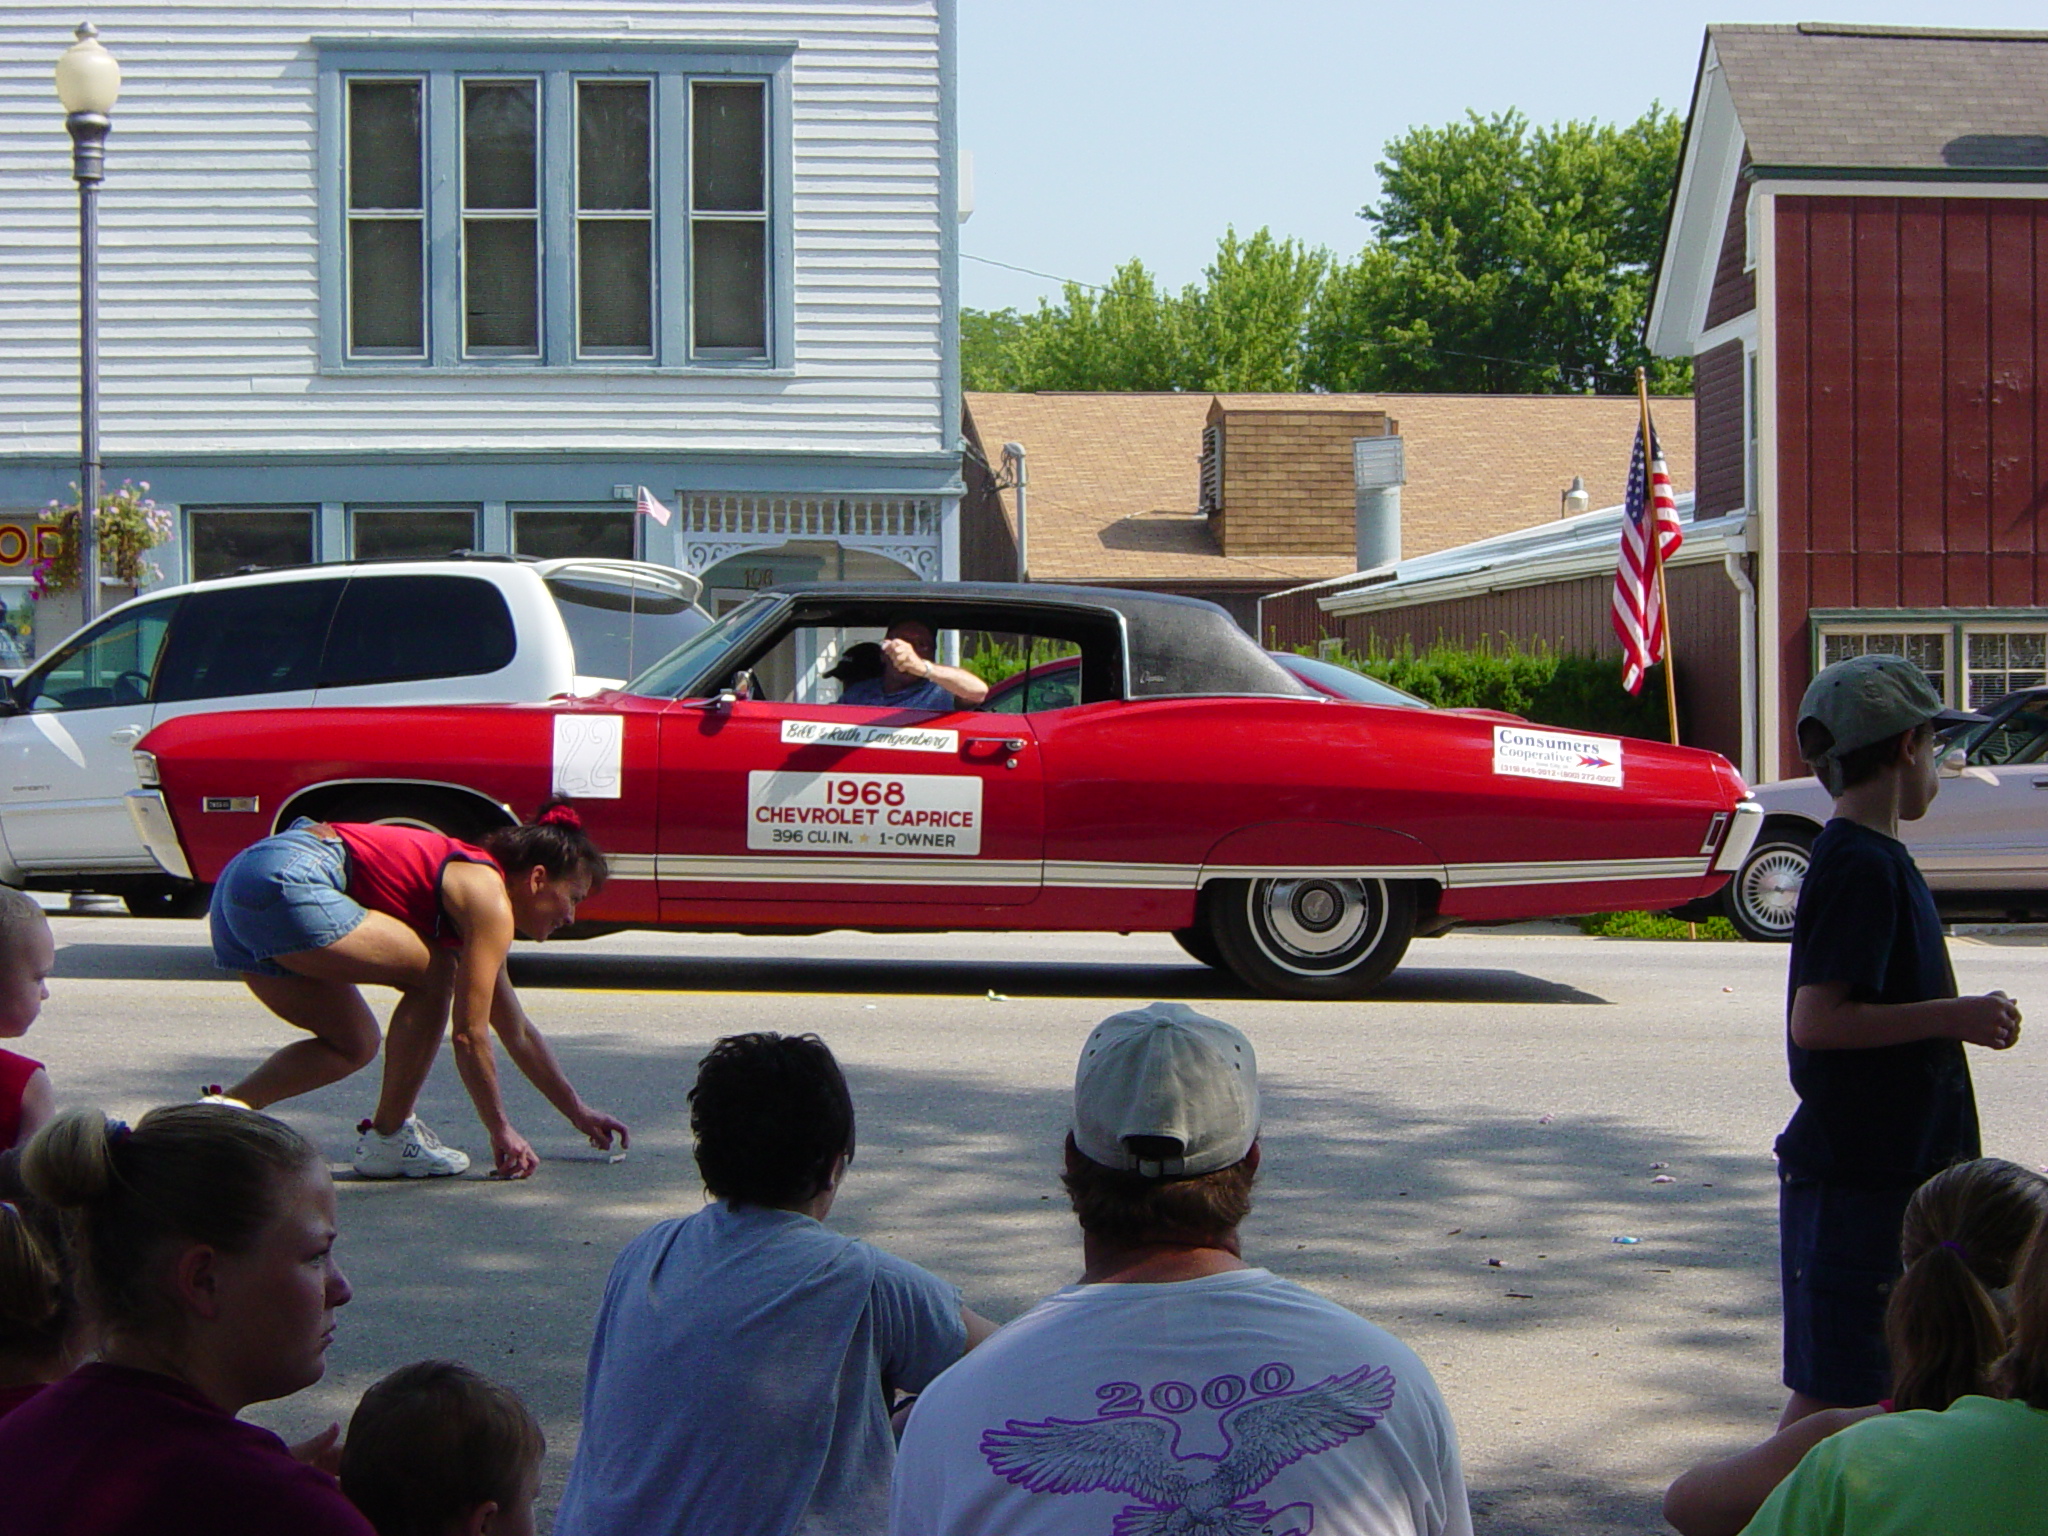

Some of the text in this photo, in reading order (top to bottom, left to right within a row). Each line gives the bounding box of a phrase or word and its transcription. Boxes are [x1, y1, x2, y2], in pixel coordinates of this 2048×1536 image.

[786, 723, 817, 739] Bill
[828, 726, 861, 742] Ruth
[1500, 729, 1600, 754] Consumers
[1500, 745, 1572, 763] Cooperative
[827, 780, 905, 806] 1968
[755, 806, 973, 828] CHEVROLET CAPRICE
[772, 829, 803, 843] 396
[879, 832, 956, 847] 1-OWNER
[1096, 1362, 1295, 1416] 2000
